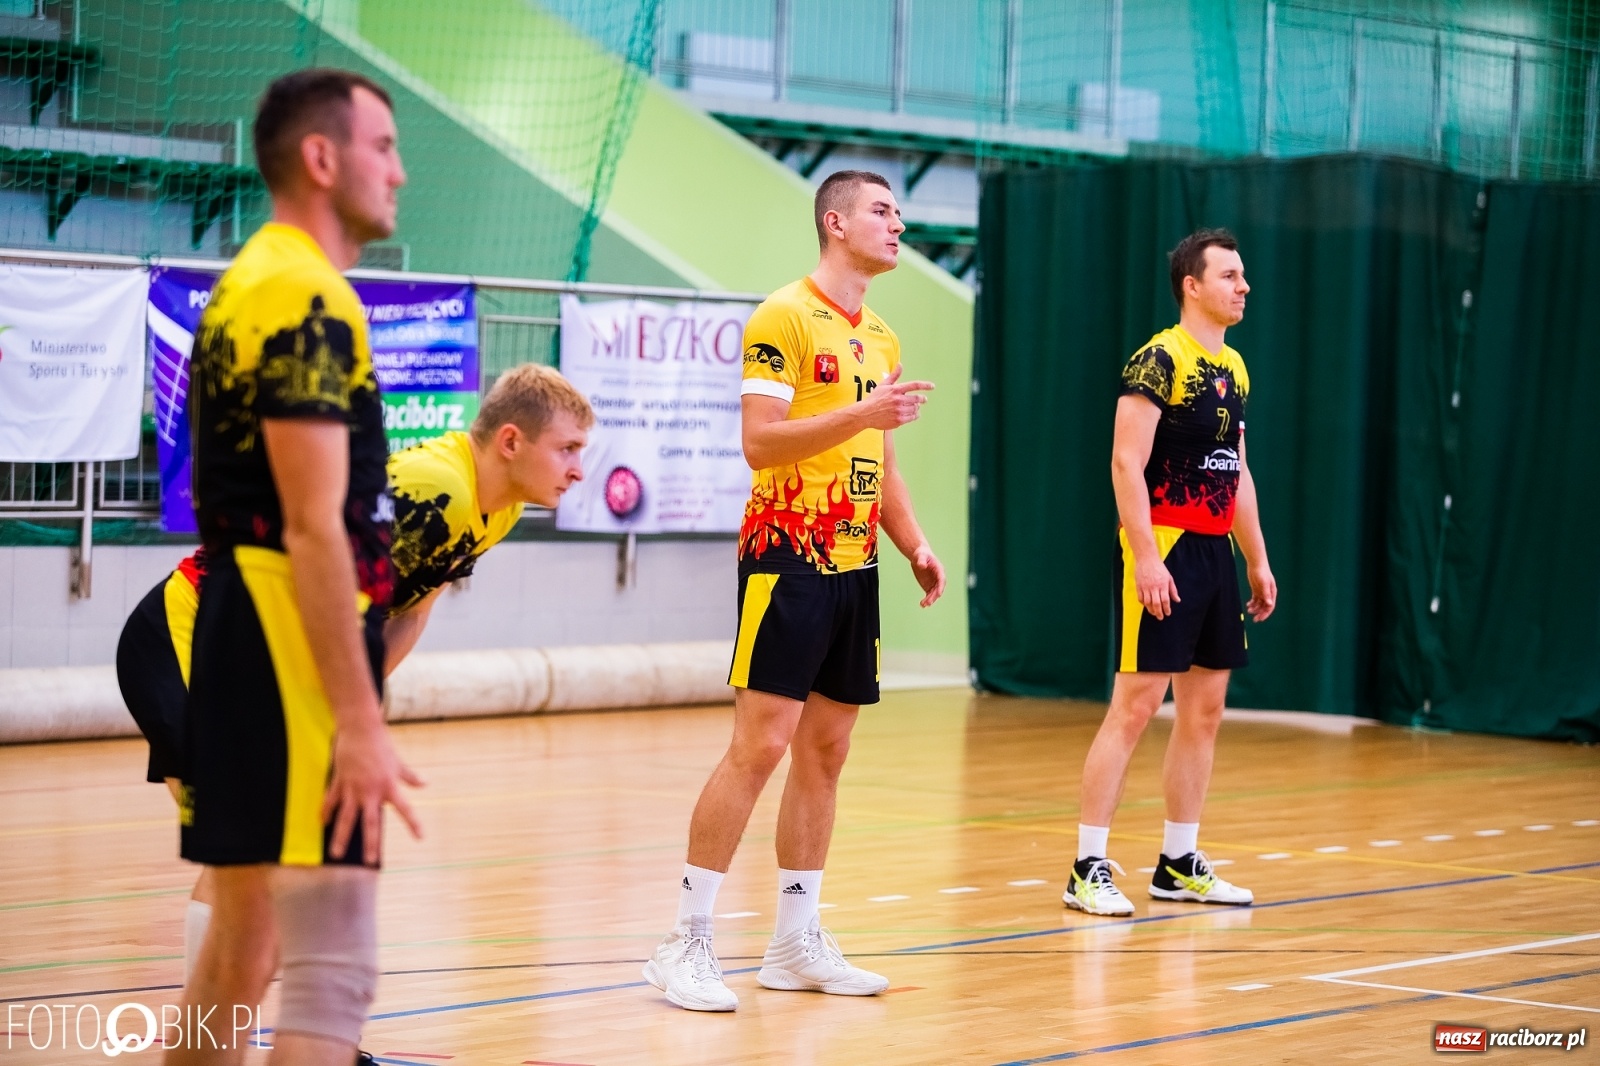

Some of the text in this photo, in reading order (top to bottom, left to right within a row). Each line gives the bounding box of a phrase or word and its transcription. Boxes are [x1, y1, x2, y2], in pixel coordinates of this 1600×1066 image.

[31, 339, 107, 354] Ministerstwo
[588, 314, 742, 365] MIESZKO
[29, 362, 67, 379] Sportu
[1216, 407, 1230, 442] 7
